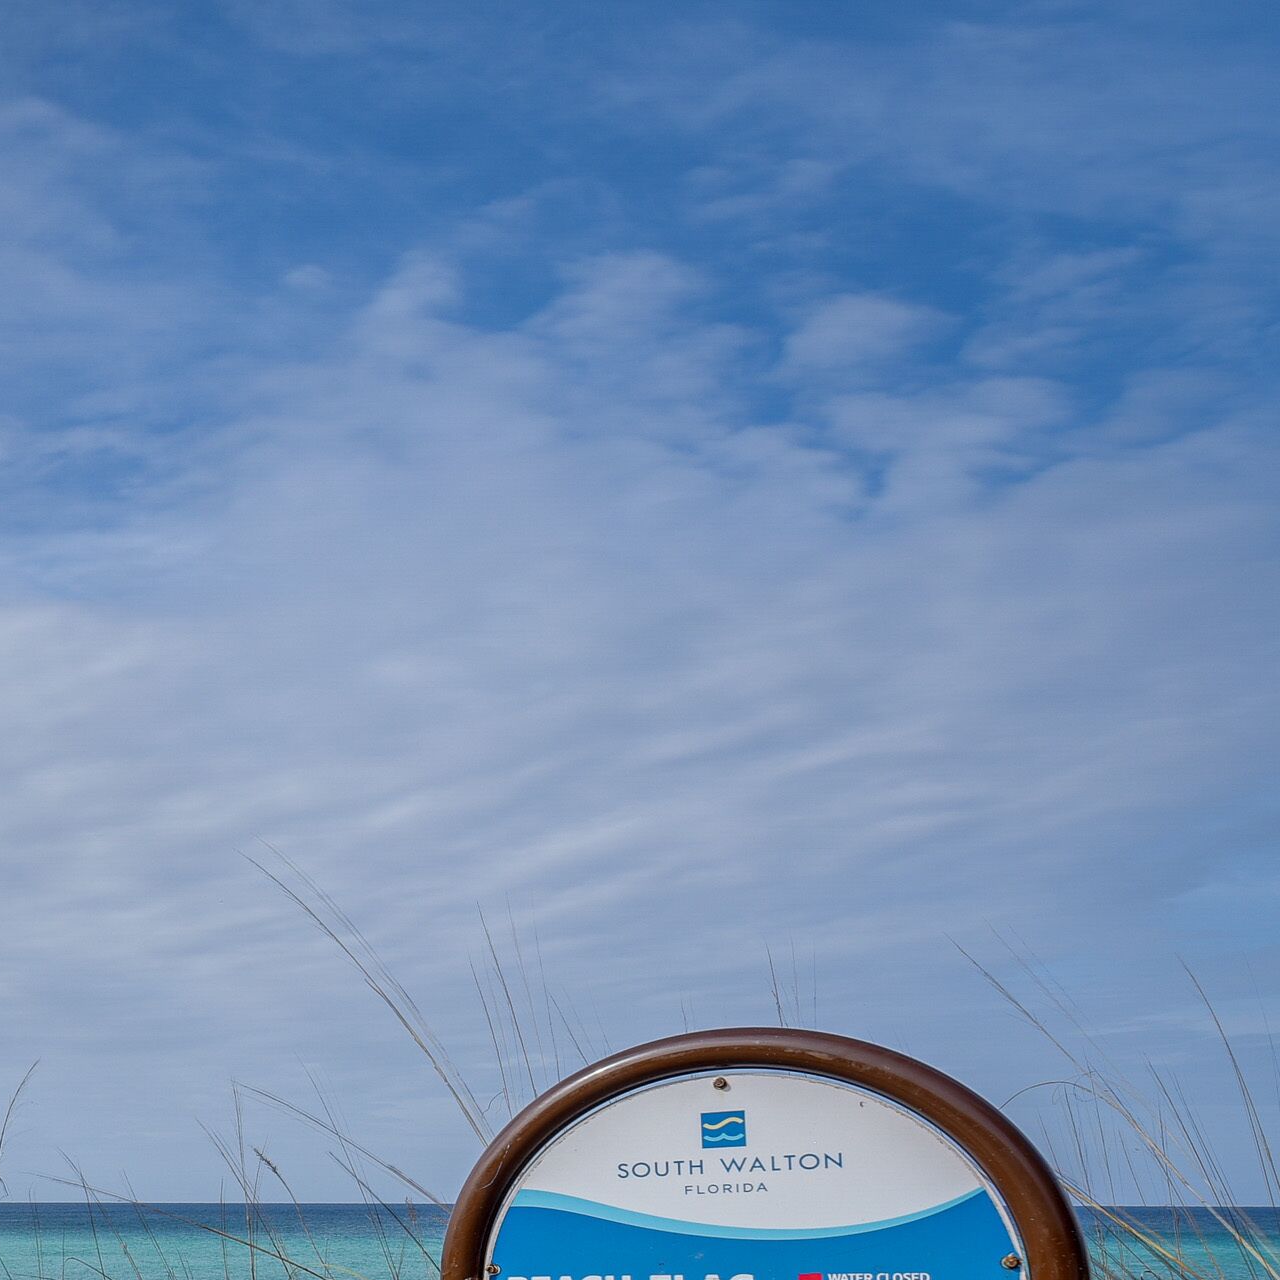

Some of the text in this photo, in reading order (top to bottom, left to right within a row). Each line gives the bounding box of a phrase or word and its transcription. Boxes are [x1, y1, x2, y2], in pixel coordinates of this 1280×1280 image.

[617, 1152, 843, 1179] SOUTH WALTON
[684, 1182, 768, 1195] FLORIDA
